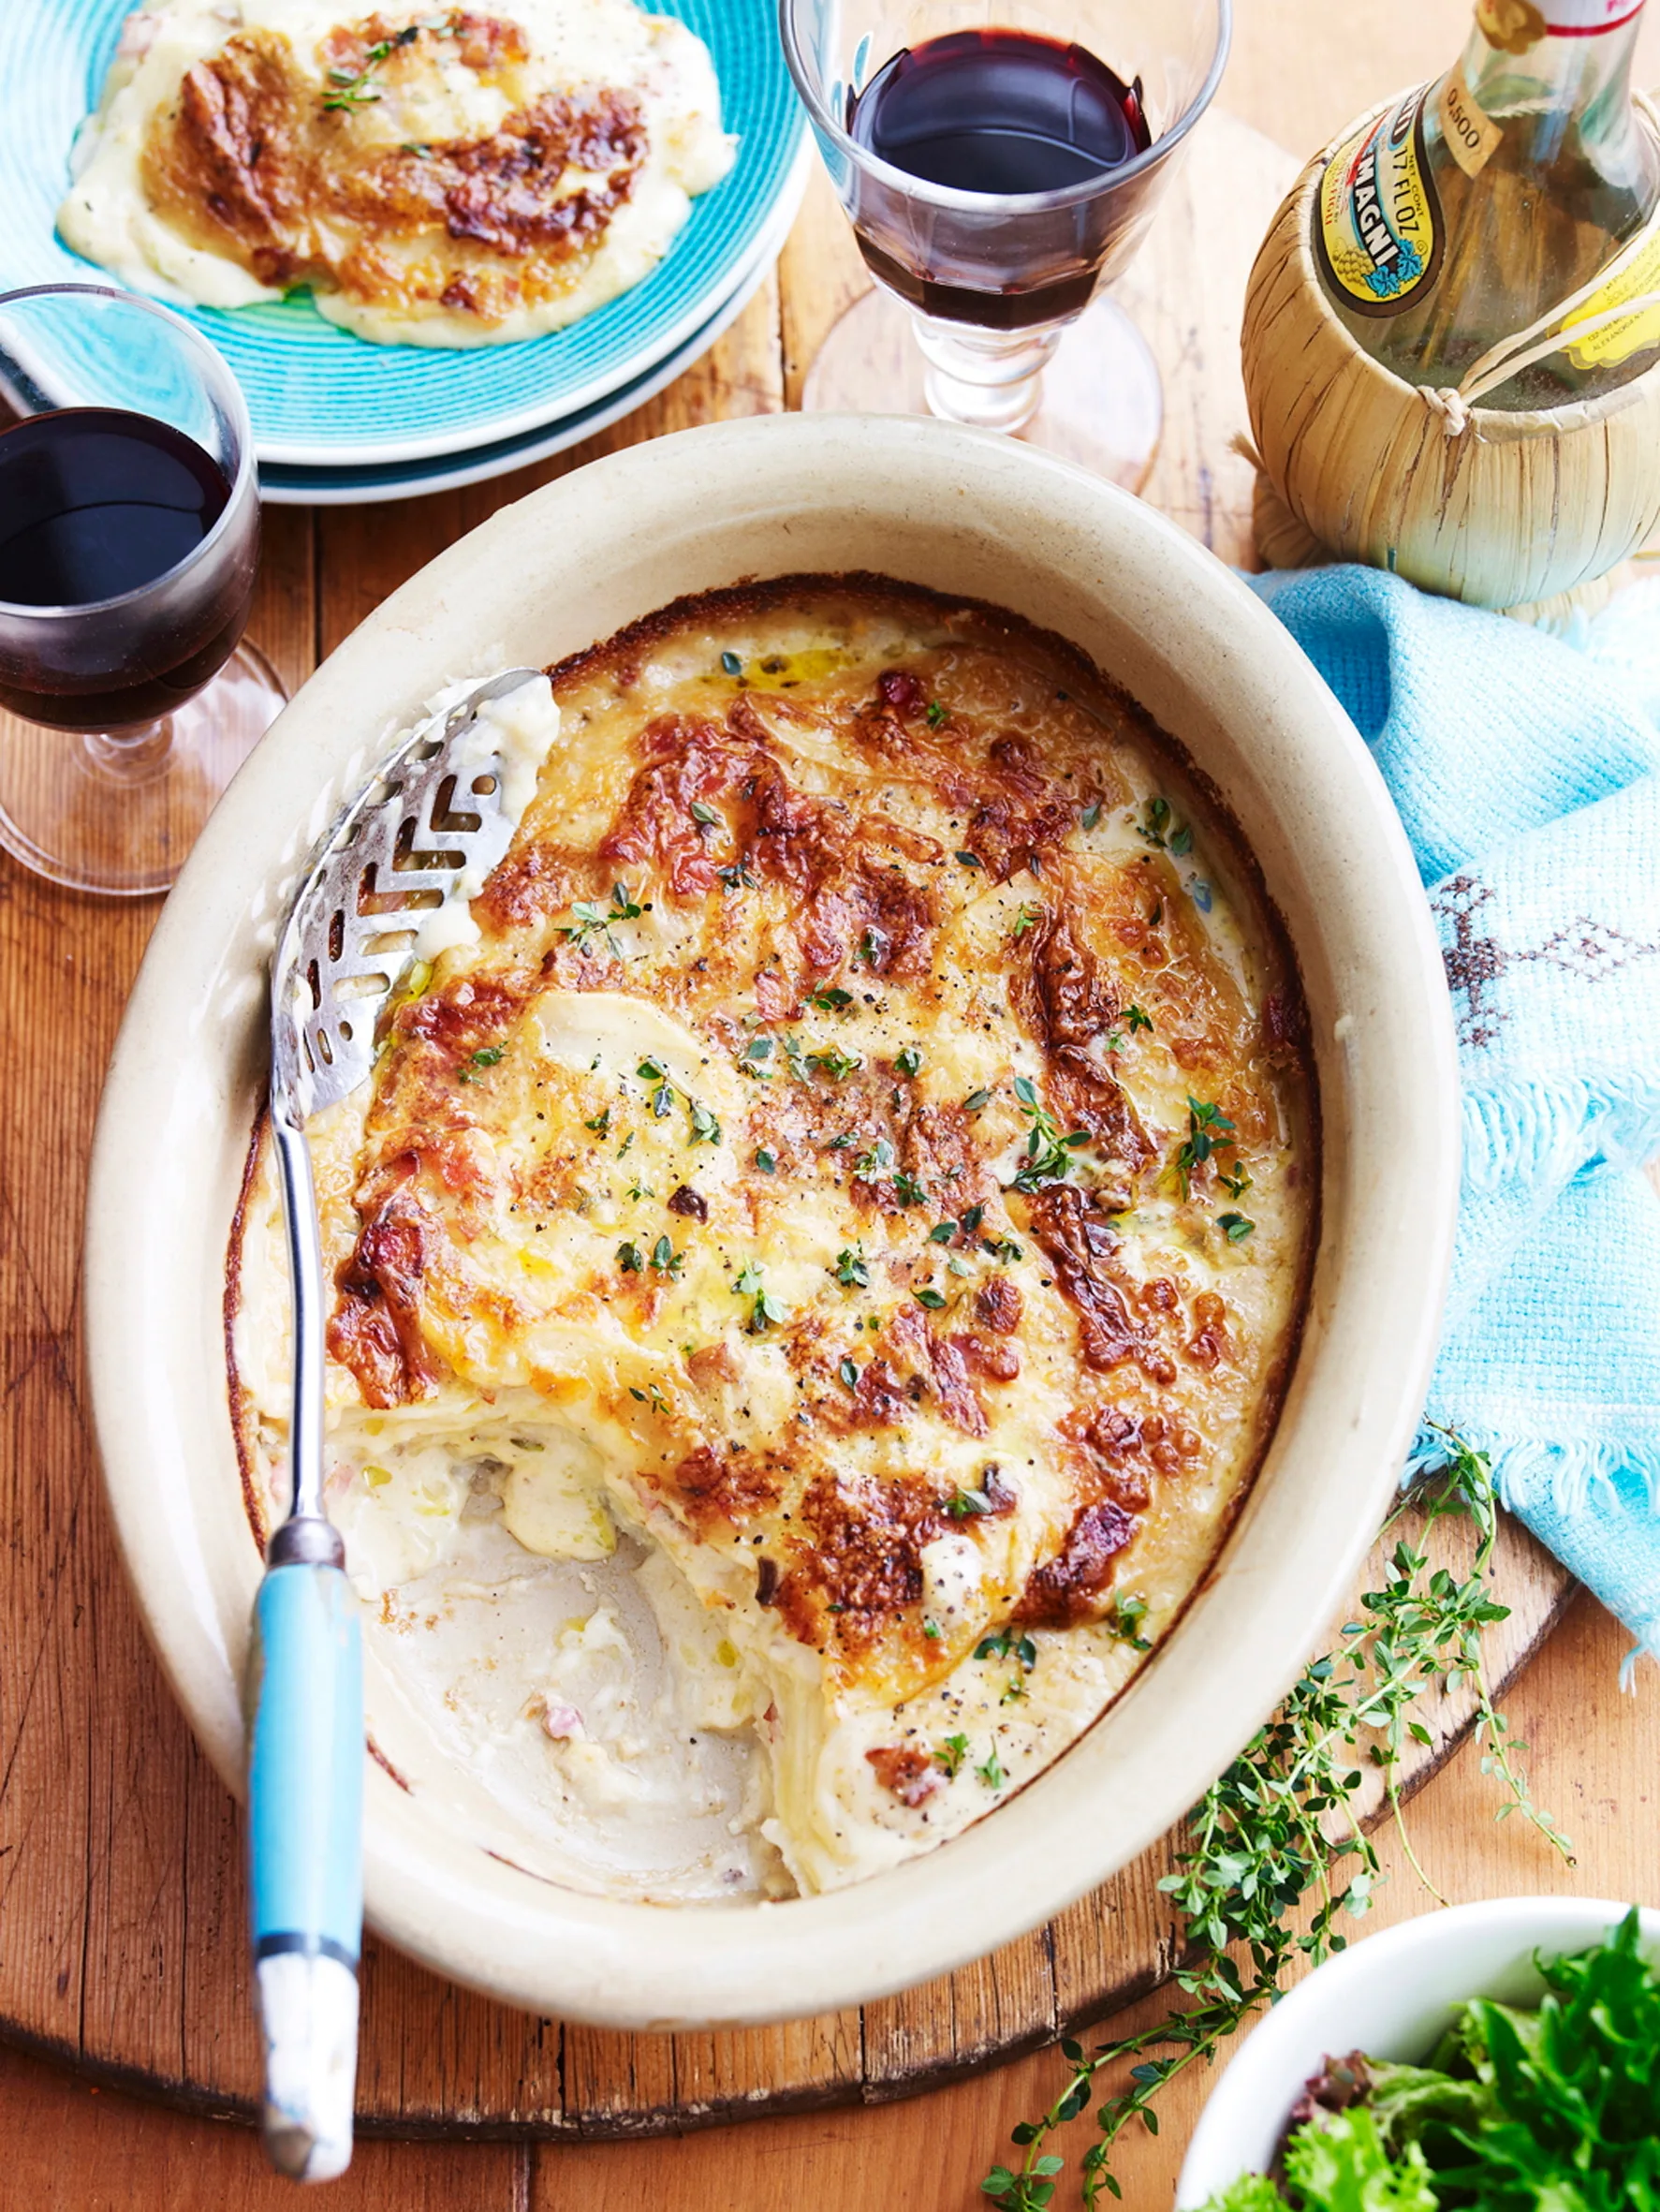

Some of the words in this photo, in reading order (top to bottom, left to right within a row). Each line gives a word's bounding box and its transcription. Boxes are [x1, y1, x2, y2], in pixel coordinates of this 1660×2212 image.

[1392, 146, 1408, 170] 17
[1407, 155, 1417, 179] NET
[1410, 184, 1425, 217] CONT
